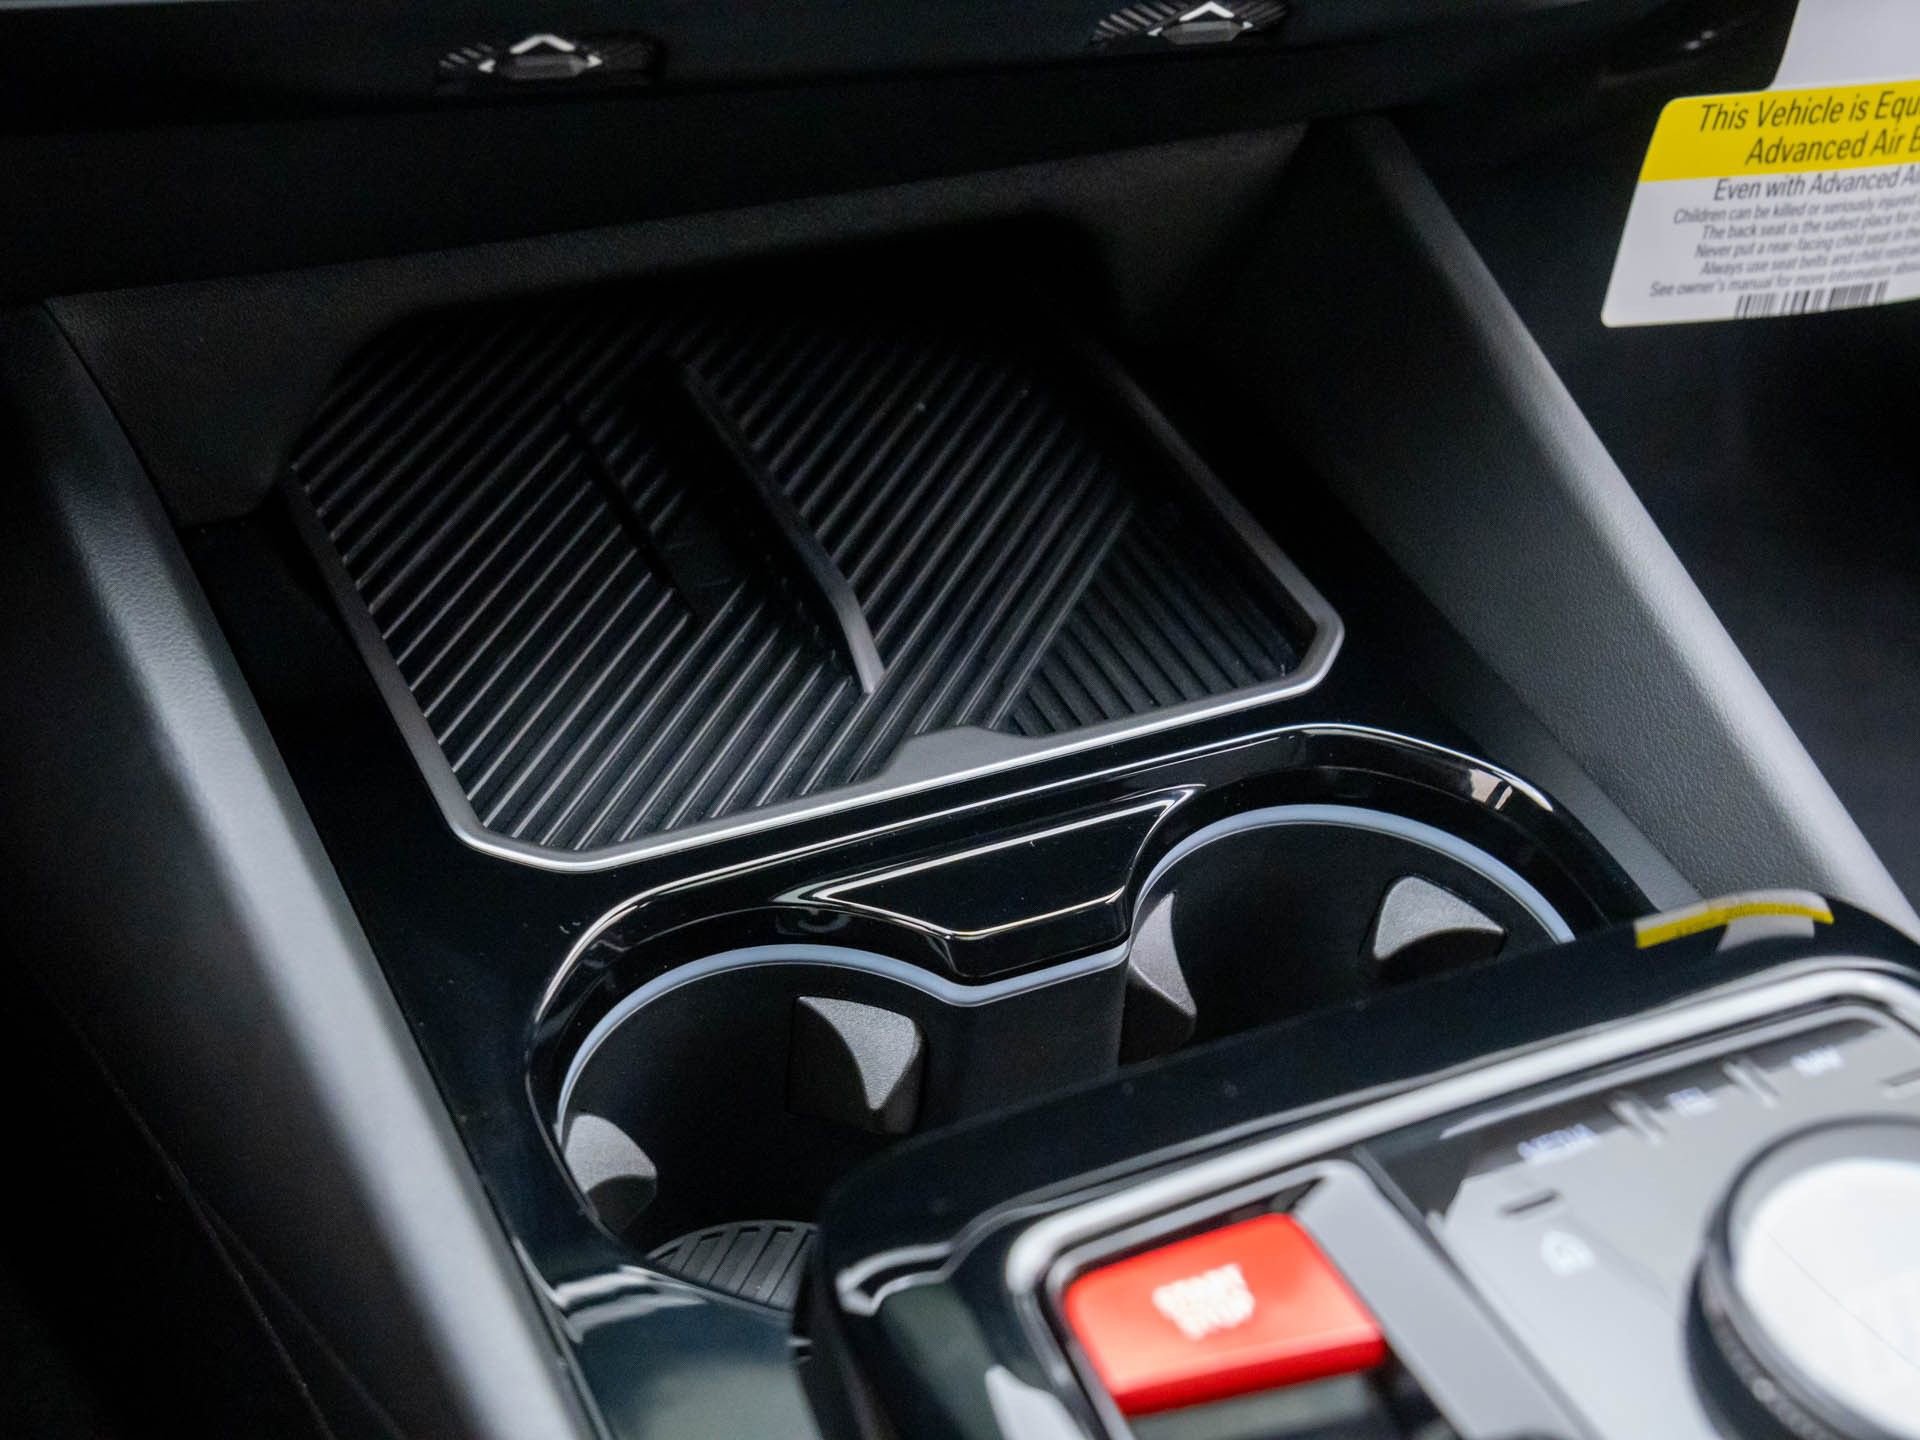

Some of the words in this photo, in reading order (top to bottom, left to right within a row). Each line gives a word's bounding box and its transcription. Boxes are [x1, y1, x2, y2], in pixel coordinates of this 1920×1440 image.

[1700, 102, 1748, 132] This
[1756, 96, 1844, 128] Vehicle
[1848, 93, 1869, 122] is
[1744, 129, 1869, 166] Advanced
[1869, 127, 1905, 157] Air
[1713, 178, 1761, 201] Even
[1766, 173, 1806, 197] with
[1808, 165, 1901, 195] Advanced
[1672, 206, 1727, 224] Children
[1728, 208, 1752, 221] can
[1753, 204, 1770, 219] be
[1772, 202, 1807, 217] killed
[1702, 223, 1726, 240] The
[1727, 223, 1757, 239] back
[1693, 243, 1731, 259] Never
[1648, 281, 1675, 297] See
